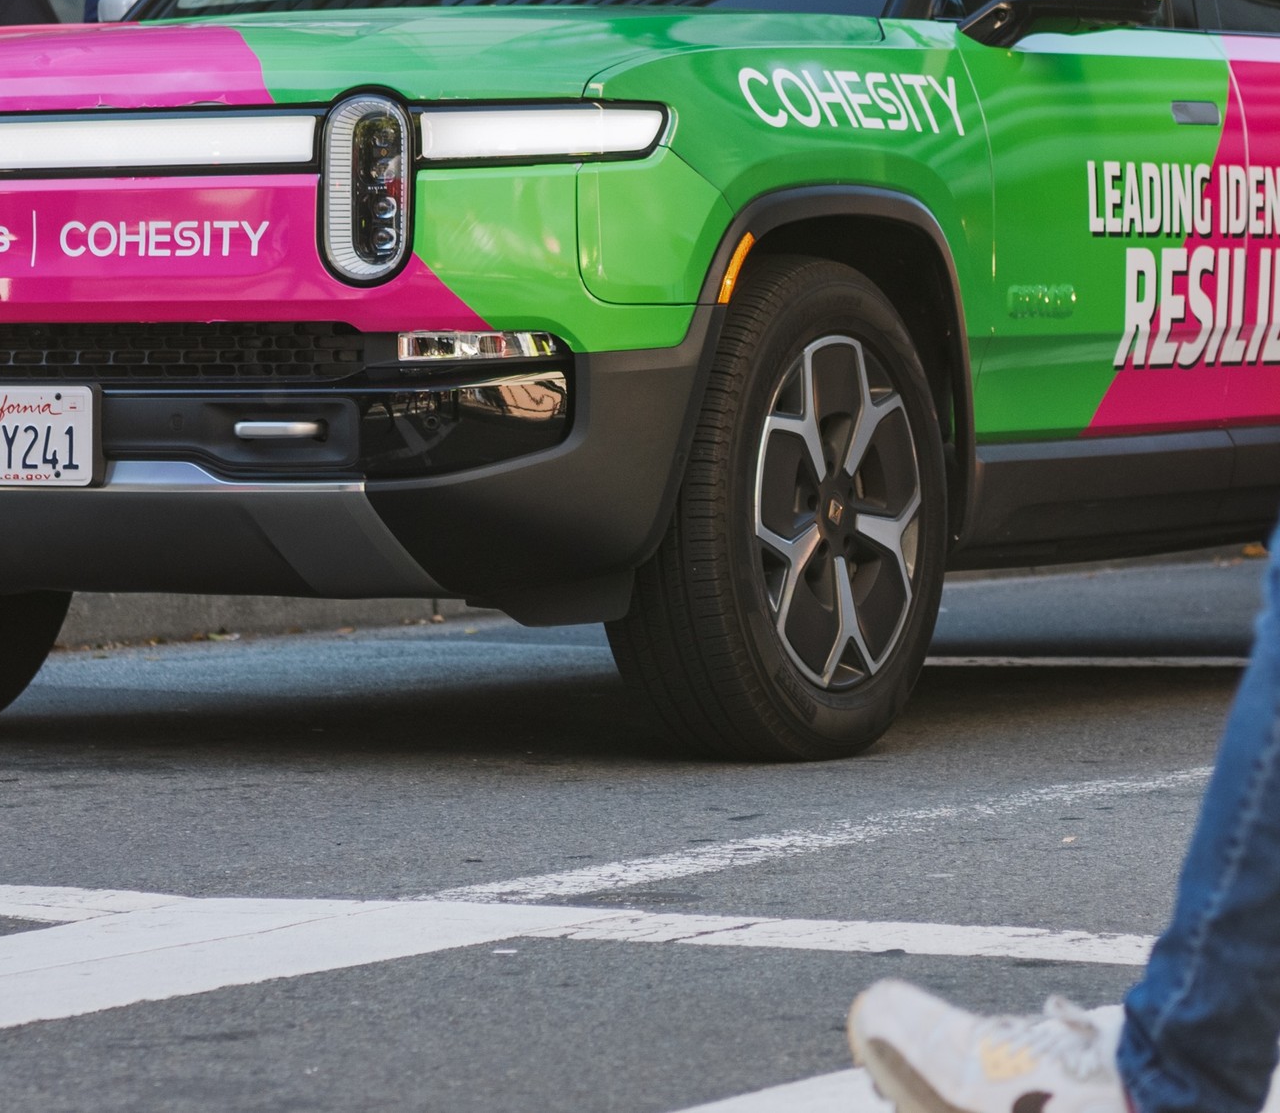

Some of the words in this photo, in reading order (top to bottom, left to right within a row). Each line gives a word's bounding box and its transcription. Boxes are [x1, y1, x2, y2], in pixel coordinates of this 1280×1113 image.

[738, 67, 965, 136] COHESITY
[1087, 160, 1212, 237] LEADING
[59, 221, 270, 257] COHESITY
